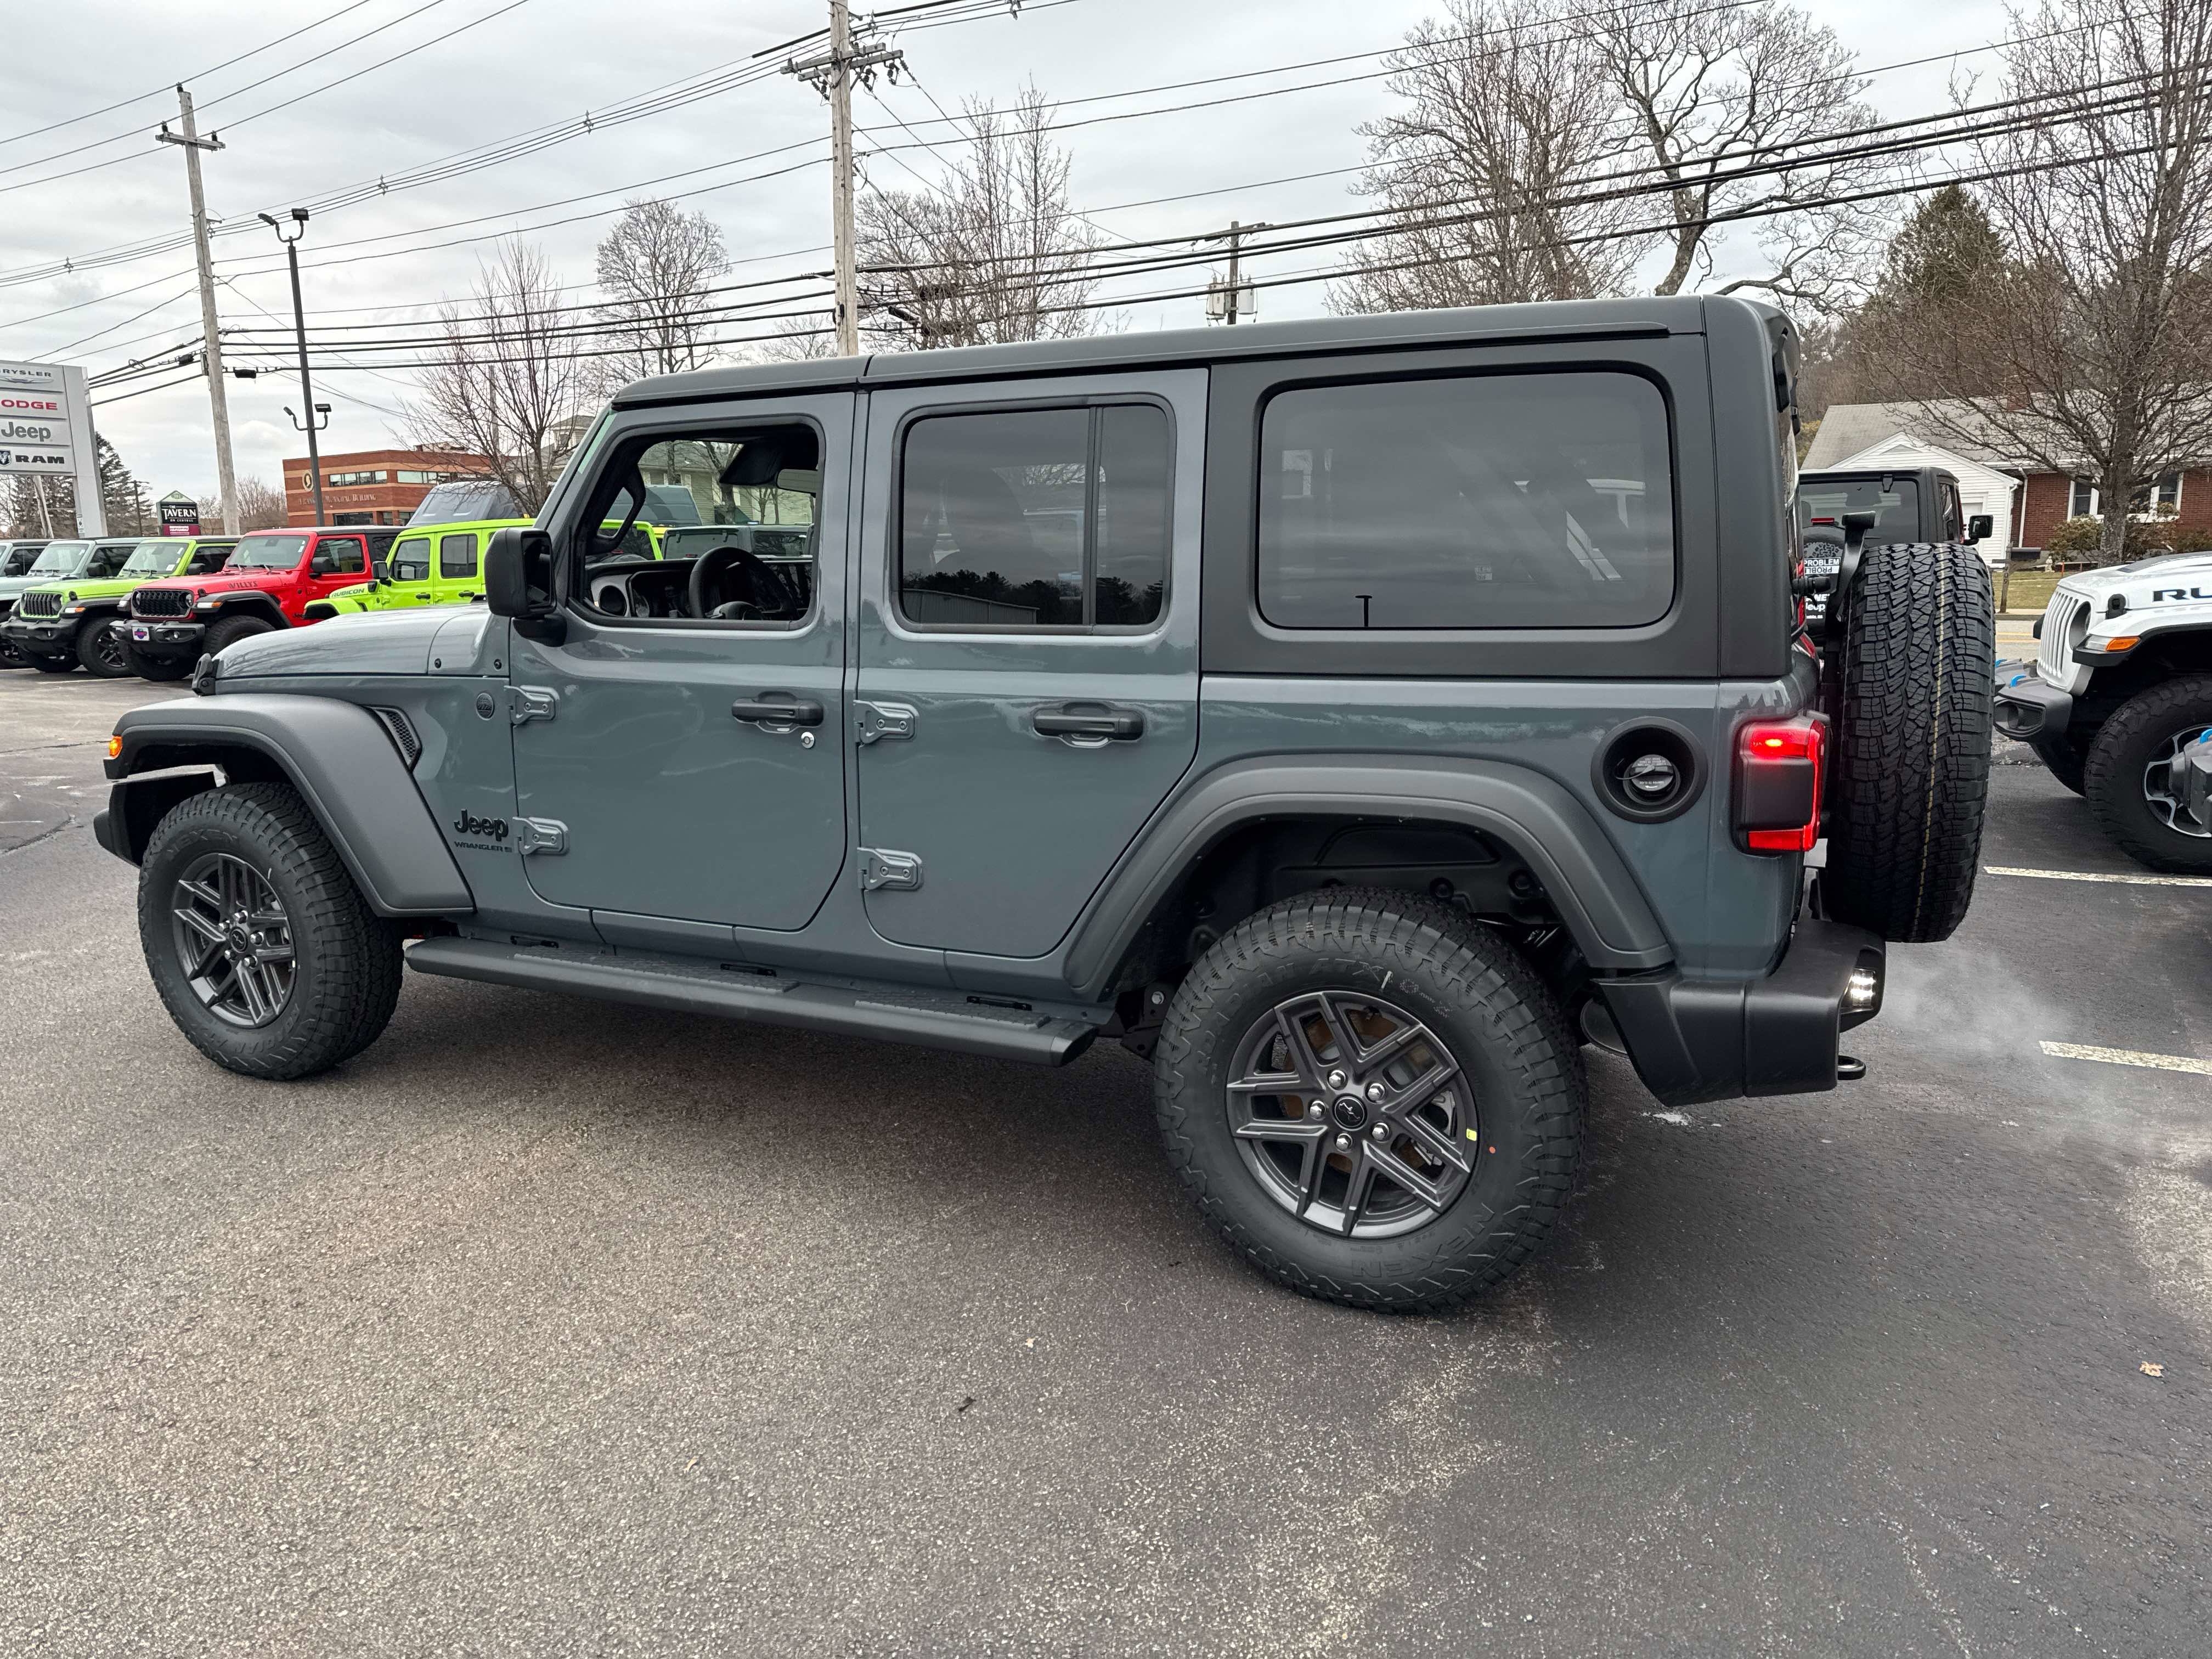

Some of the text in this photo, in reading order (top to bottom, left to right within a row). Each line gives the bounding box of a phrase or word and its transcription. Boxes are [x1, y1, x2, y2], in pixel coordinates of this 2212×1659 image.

[0, 369, 52, 377] RYSLER
[1, 399, 58, 410] ODGE
[1, 421, 51, 442] Jeep
[15, 455, 65, 464] RAM
[352, 493, 376, 501] BUILDING
[161, 509, 196, 520] TAVERN
[228, 581, 258, 589] WILLYS
[331, 588, 365, 597] RUBICON
[2152, 587, 2212, 602] RU
[454, 808, 509, 842] Jeep
[454, 841, 503, 852] WRANGLER
